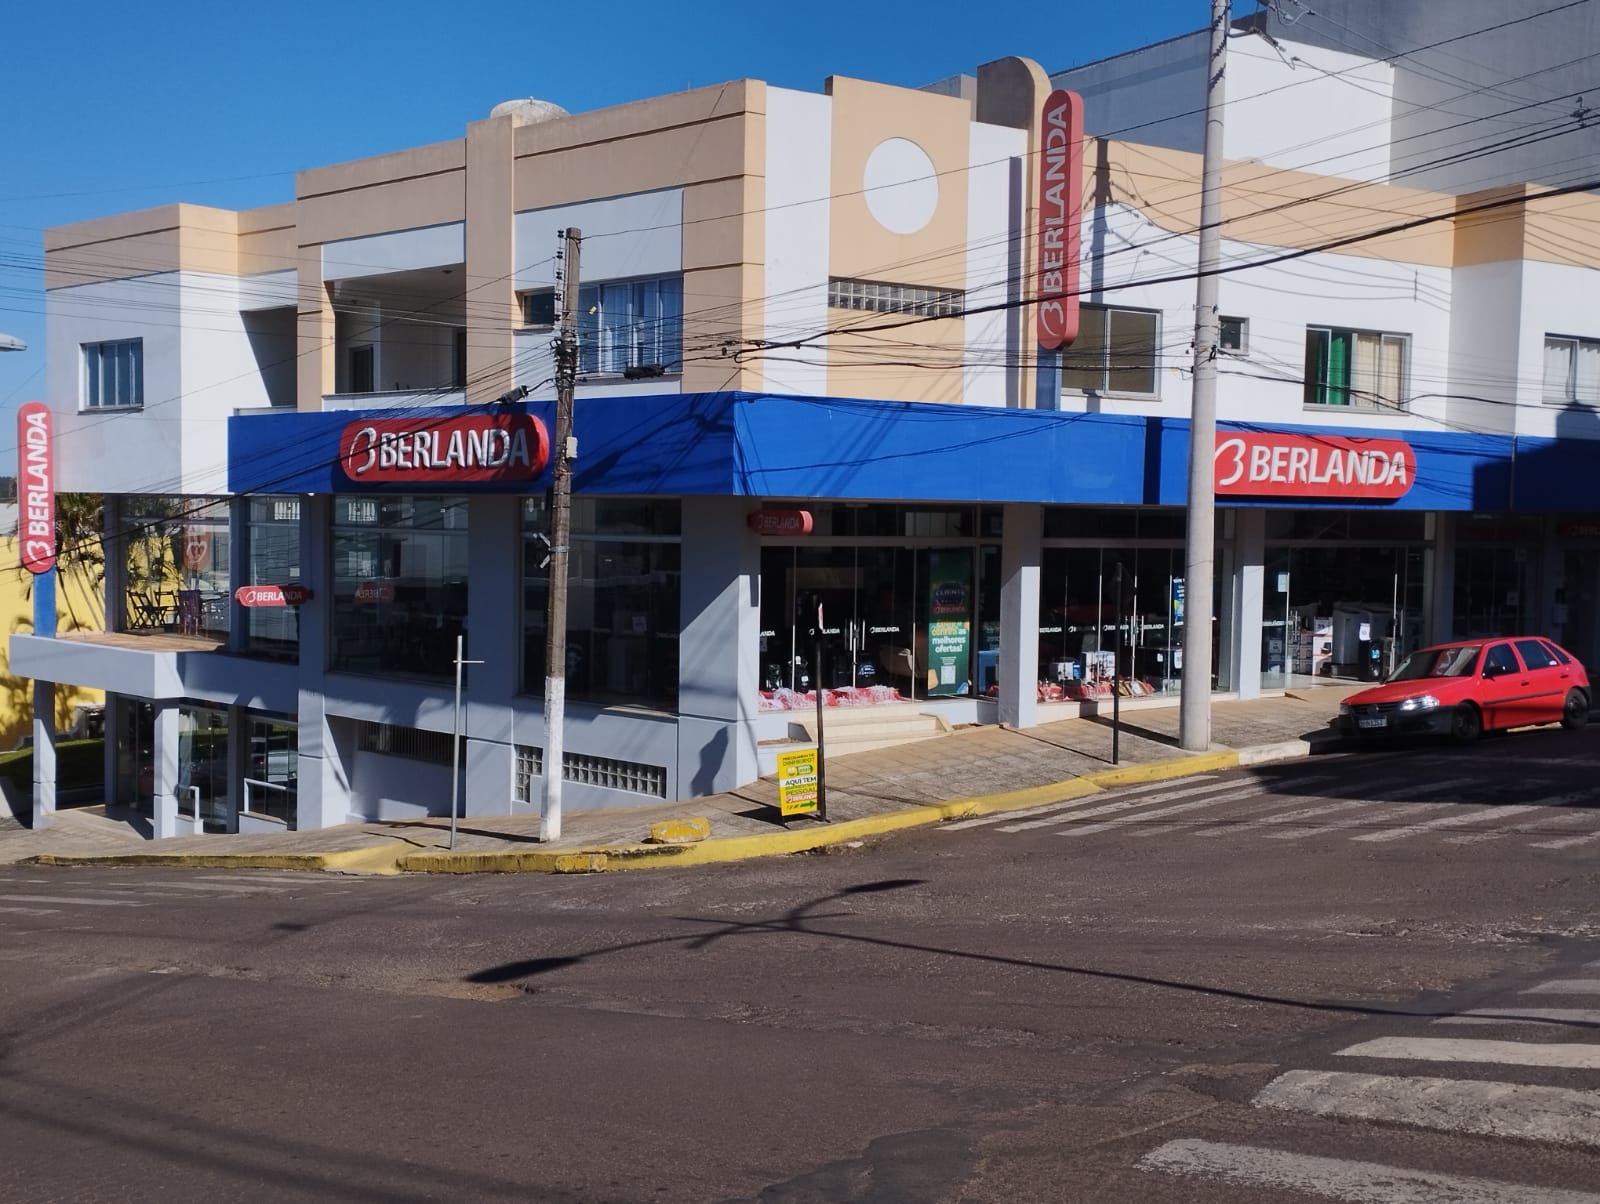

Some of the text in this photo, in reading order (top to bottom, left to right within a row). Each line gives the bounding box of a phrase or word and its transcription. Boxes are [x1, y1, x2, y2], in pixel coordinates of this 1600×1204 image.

[1043, 103, 1067, 293] BERLANDA
[379, 428, 530, 469] BERLANDA
[26, 412, 49, 536] BERLANDA
[1249, 445, 1407, 486] BERLANDA
[256, 591, 302, 602] BERLANDA
[932, 636, 966, 645] melhores
[935, 644, 963, 653] ofertas!
[785, 778, 802, 787] AQUI
